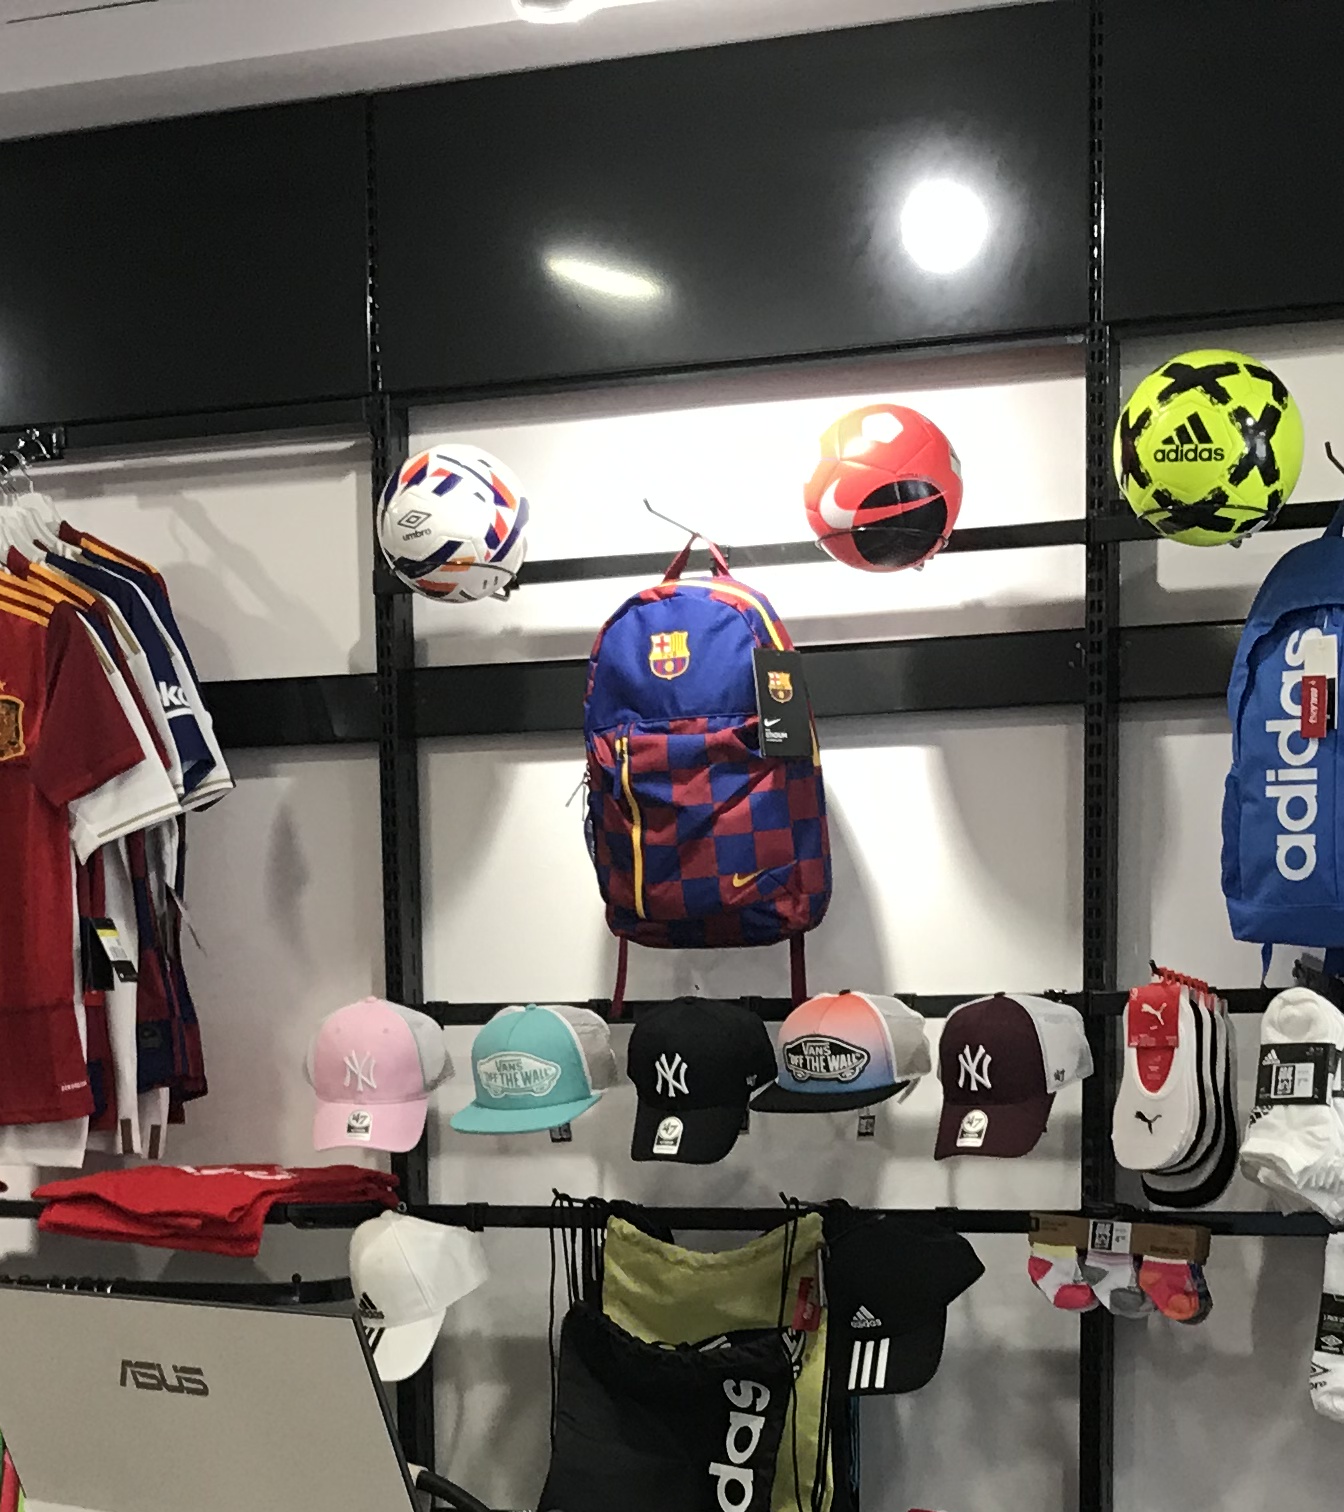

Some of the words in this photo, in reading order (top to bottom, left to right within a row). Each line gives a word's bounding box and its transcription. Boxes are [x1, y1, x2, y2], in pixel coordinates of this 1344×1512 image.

[1153, 444, 1225, 463] adidas
[402, 528, 432, 542] umbro
[802, 1041, 831, 1056] VANS
[494, 1058, 524, 1073] VANS
[805, 1055, 828, 1073] THE
[498, 1071, 519, 1089] THE
[850, 1318, 882, 1329] adidas
[120, 1359, 210, 1398] ASUS
